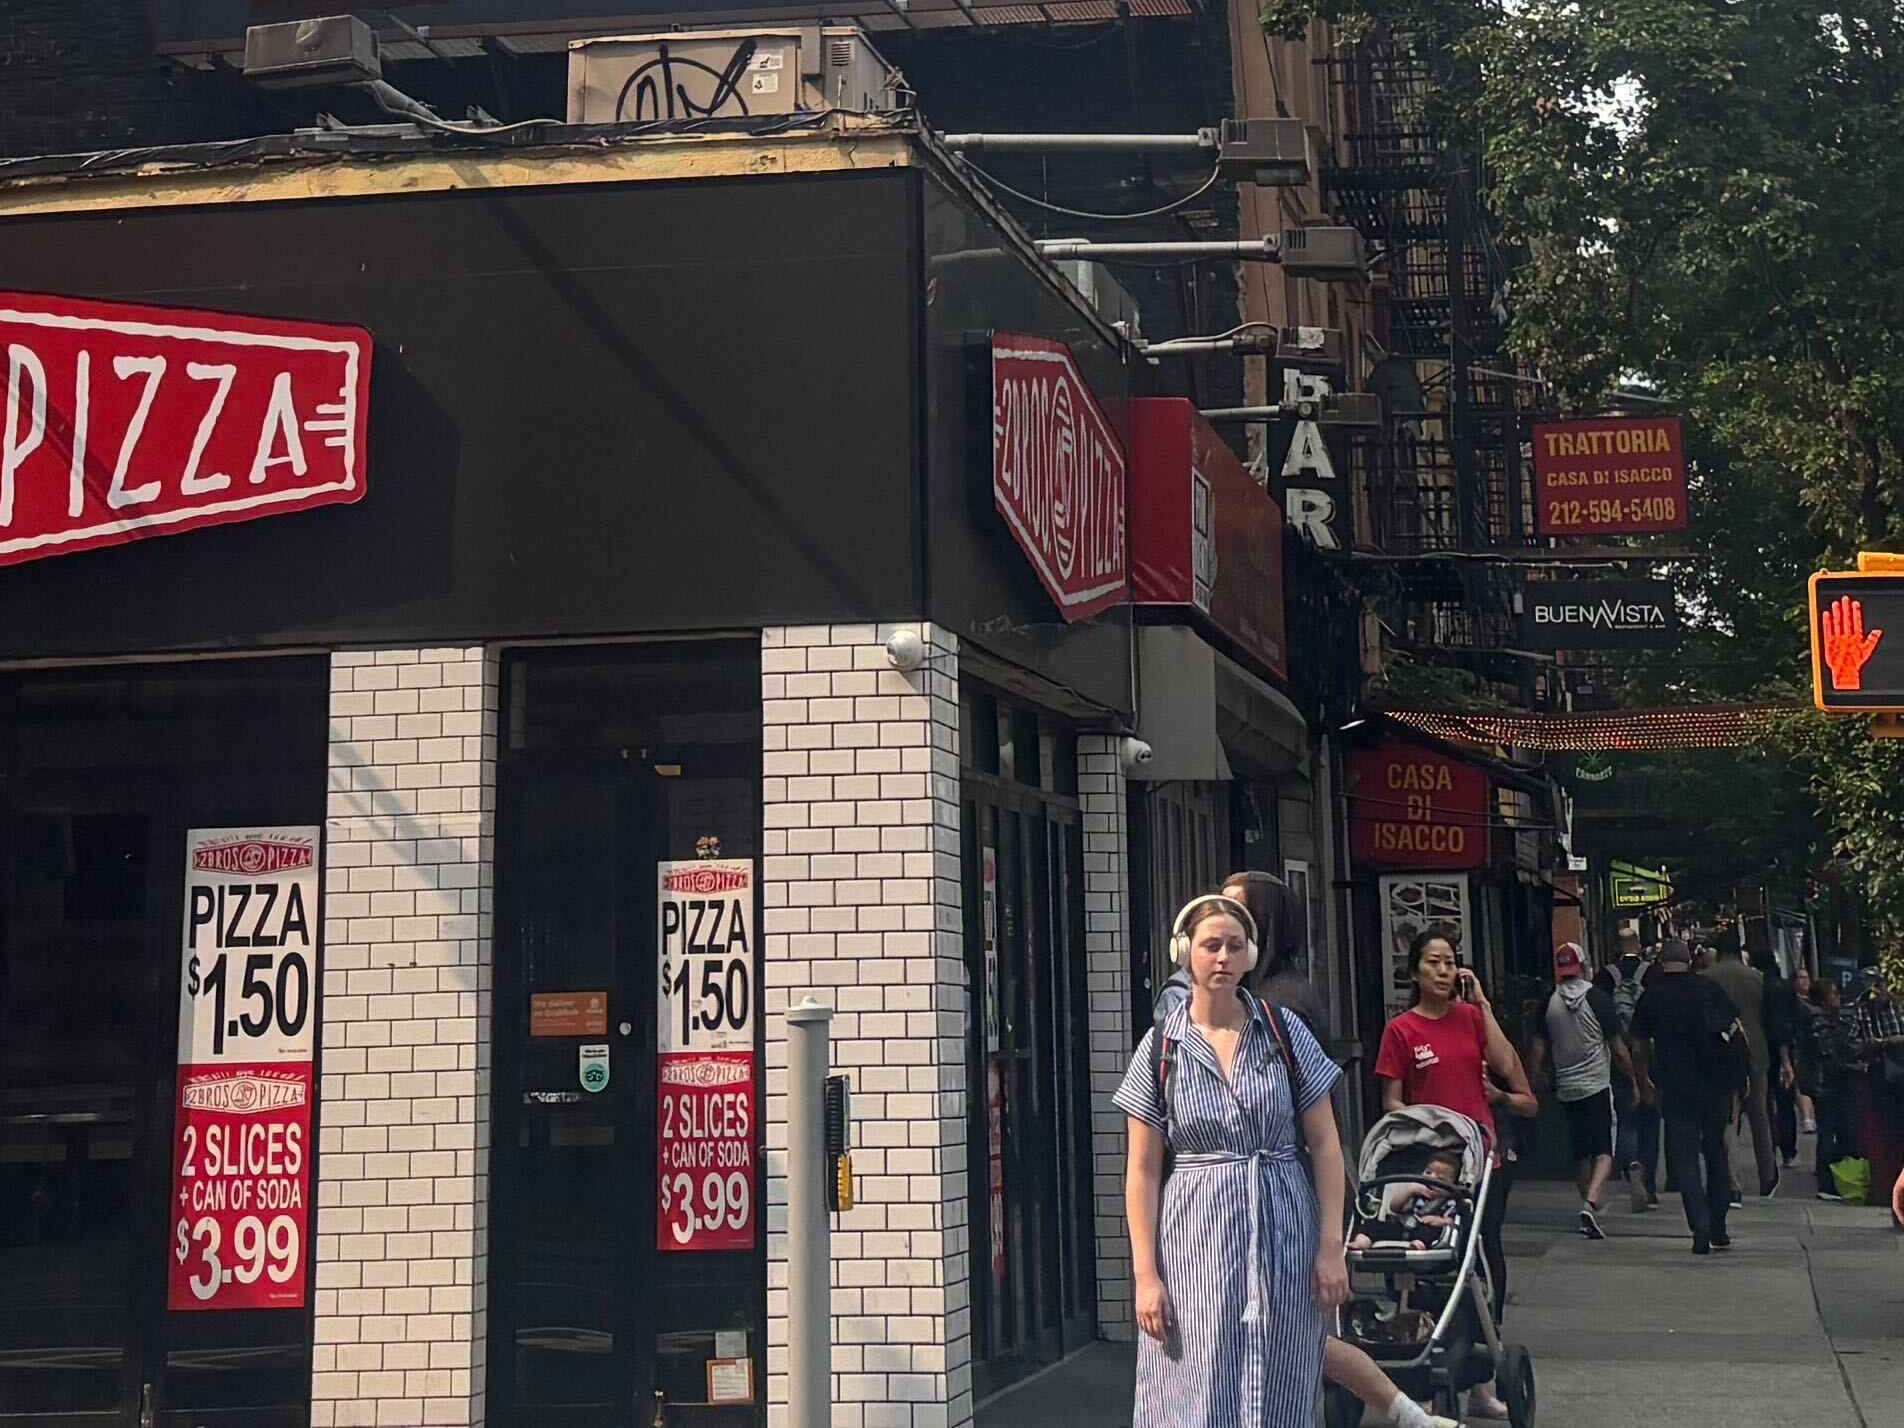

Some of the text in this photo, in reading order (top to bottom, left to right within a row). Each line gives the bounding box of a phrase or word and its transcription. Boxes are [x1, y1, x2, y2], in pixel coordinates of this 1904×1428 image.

[0, 343, 307, 528] PIZZA
[1281, 367, 1341, 552] BAR
[1545, 429, 1671, 456] TRATTORIA
[1547, 470, 1588, 487] CASA
[1614, 467, 1672, 484] ISACCO
[1549, 497, 1676, 525] 212-594-5408
[1387, 763, 1453, 791] CASA
[1408, 795, 1432, 821] DI
[1374, 823, 1464, 853] ISACCO
[189, 883, 310, 948] PIZZA
[662, 899, 750, 955] PIZZA
[187, 952, 308, 1055] $1.50
[662, 958, 749, 1046] $1.50
[663, 1092, 748, 1138] 2 SLICES
[181, 1122, 302, 1176] 2 SLICES
[672, 1142, 695, 1168] CAN
[698, 1141, 714, 1168] OF
[717, 1141, 750, 1167] SODA
[192, 1179, 226, 1211] CAN
[230, 1179, 253, 1211] OF
[256, 1178, 302, 1210] SODA
[661, 1171, 750, 1244] $3.99
[175, 1214, 300, 1300] $3.99
